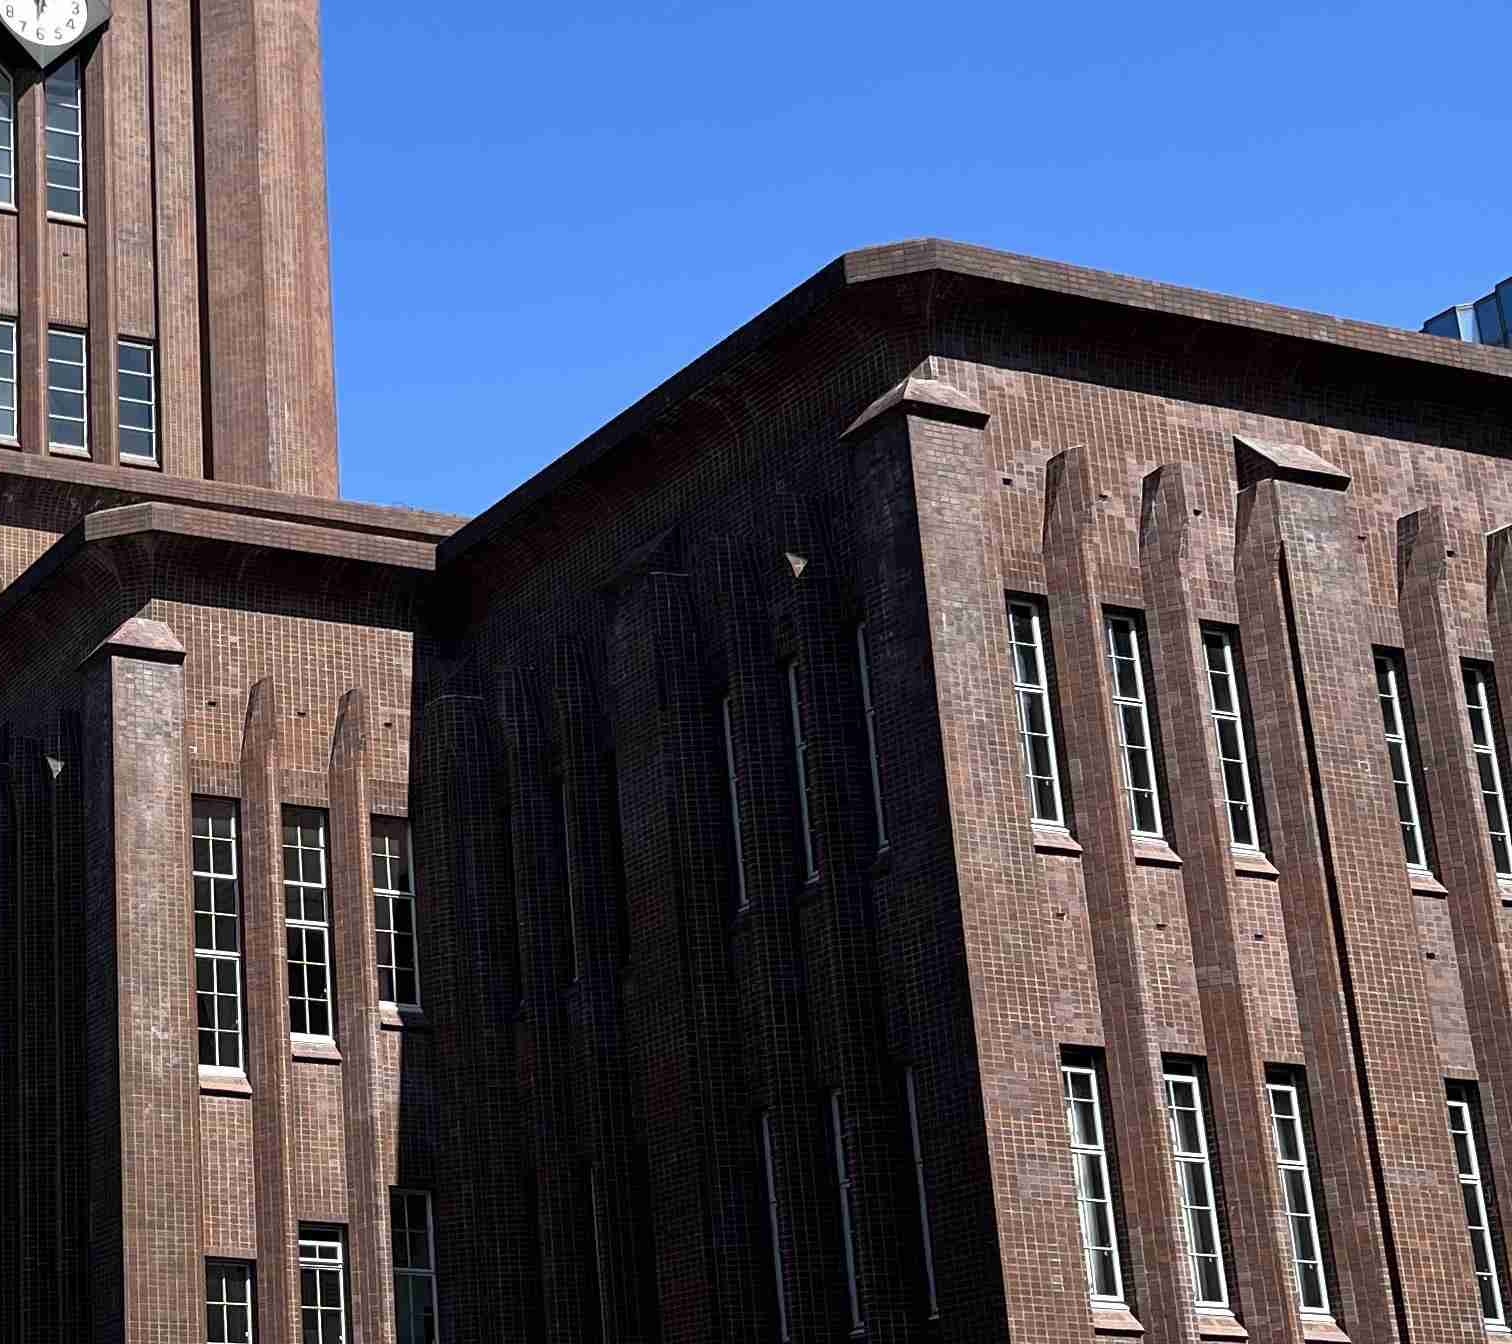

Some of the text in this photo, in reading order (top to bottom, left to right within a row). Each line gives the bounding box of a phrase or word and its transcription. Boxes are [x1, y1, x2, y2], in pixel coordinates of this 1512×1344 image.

[6, 4, 14, 18] 8
[71, 1, 80, 15] 3
[18, 20, 27, 33] 7
[65, 18, 75, 30] 4
[36, 27, 45, 41] 6
[54, 27, 63, 40] 5
